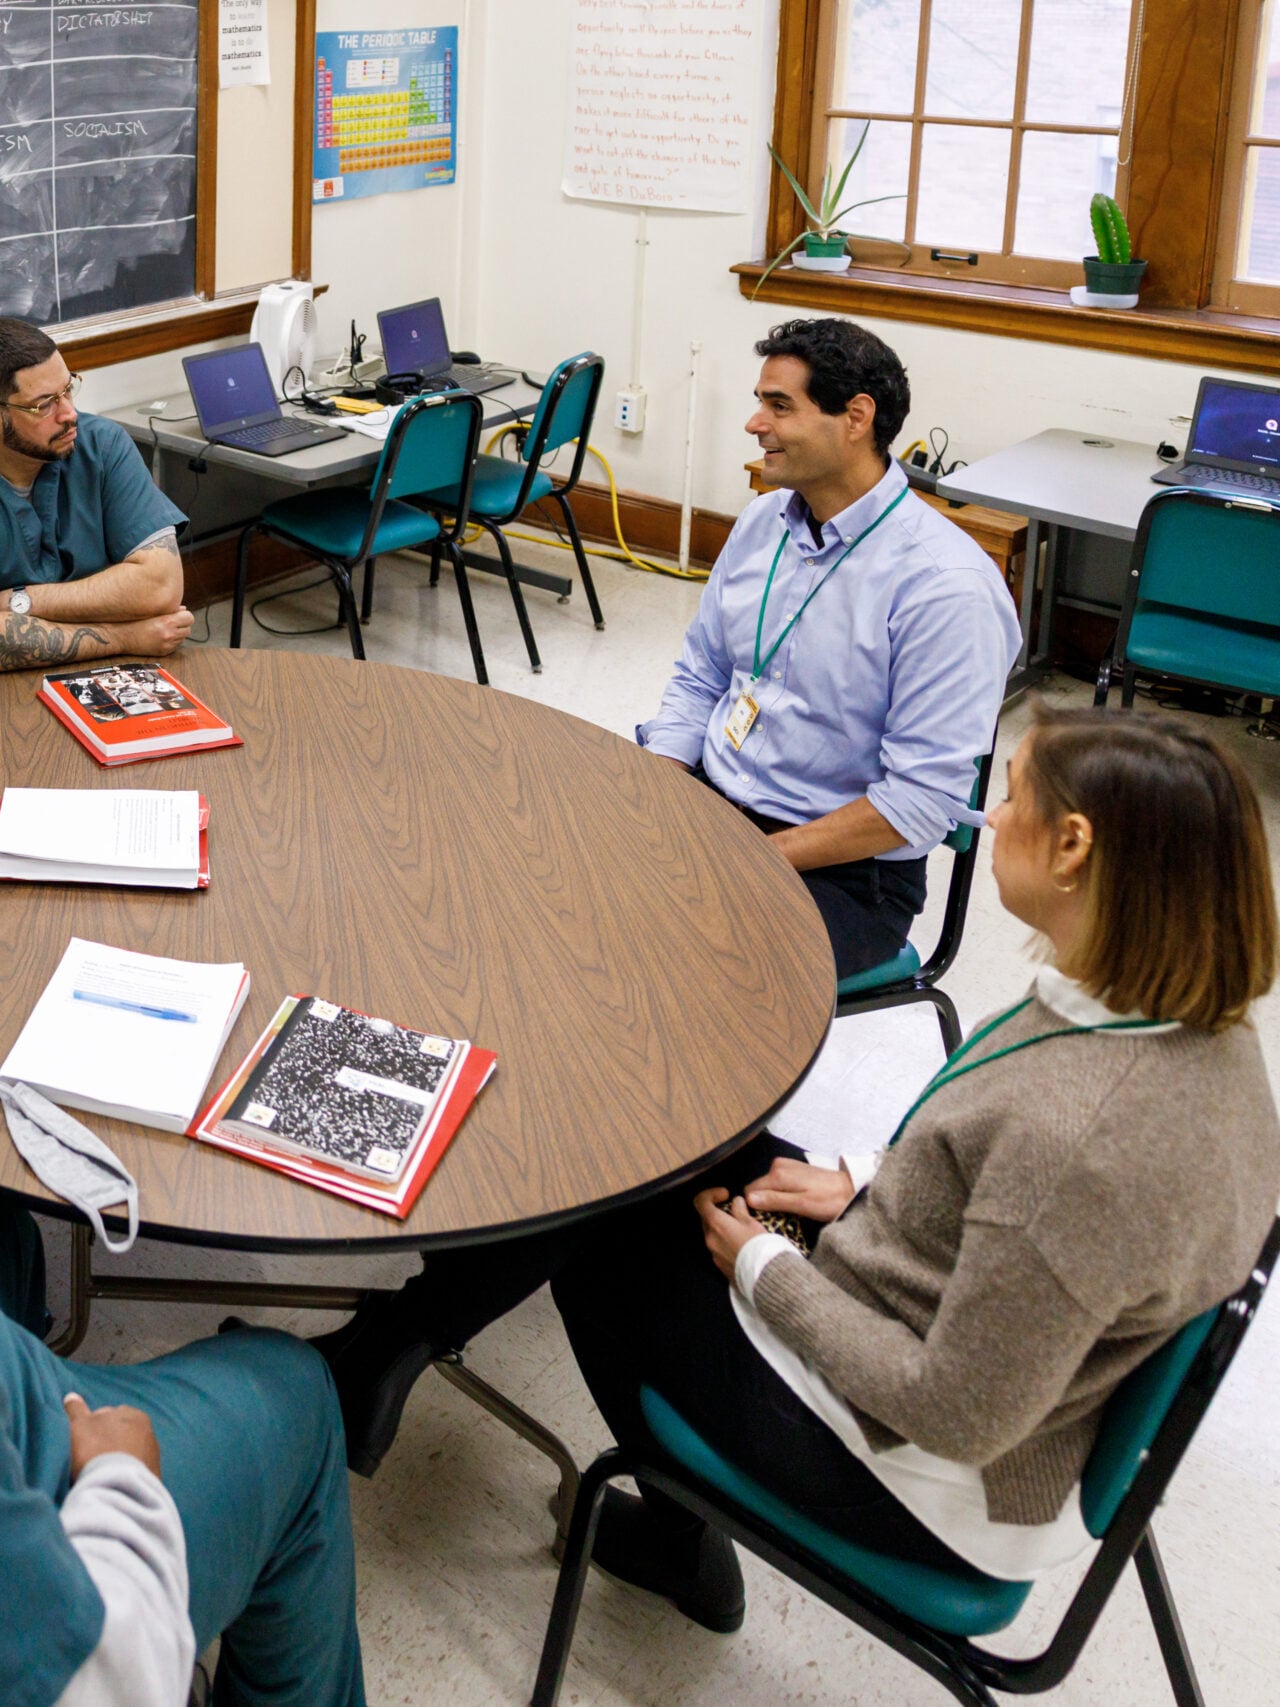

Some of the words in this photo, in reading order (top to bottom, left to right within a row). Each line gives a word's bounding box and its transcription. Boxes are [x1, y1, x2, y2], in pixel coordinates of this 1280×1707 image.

[222, 26, 262, 34] mathematics
[338, 35, 359, 49] THE
[362, 32, 406, 48] PERIODIC
[408, 30, 437, 45] TABLE
[63, 120, 147, 138] SOCIALISM
